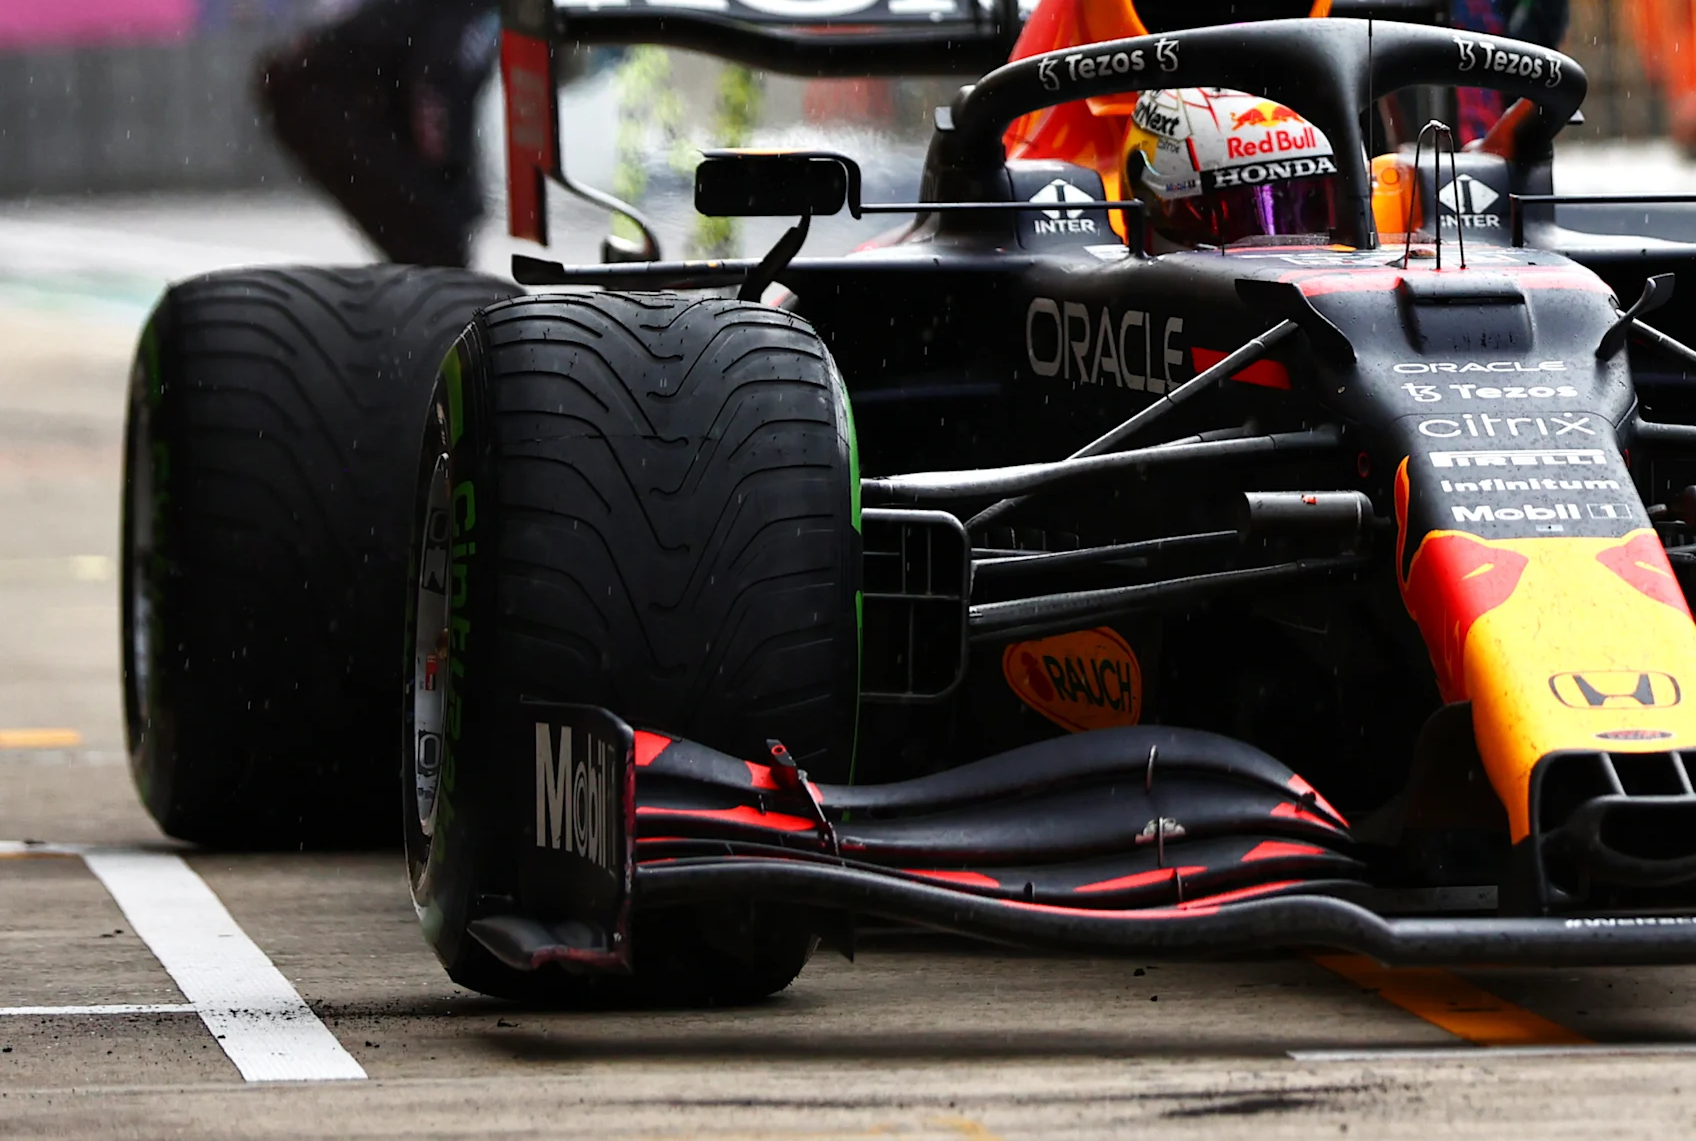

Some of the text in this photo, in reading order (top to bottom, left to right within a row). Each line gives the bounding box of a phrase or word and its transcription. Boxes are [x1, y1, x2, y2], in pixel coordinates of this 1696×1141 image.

[1064, 49, 1144, 78] Tezos
[1479, 43, 1544, 79] Tezos
[1227, 127, 1317, 159] Red Bull
[1213, 156, 1338, 189] HONDA
[1034, 219, 1097, 234] INTER
[1439, 214, 1501, 228] INTER
[1025, 296, 1185, 395] ORACLE
[1393, 360, 1568, 374] ORACLE
[1449, 383, 1579, 399] Tezos
[1418, 412, 1597, 438] citrix
[1429, 449, 1608, 468] PIRELLI
[1451, 503, 1582, 522] Mobil
[1042, 654, 1134, 715] RAUCH
[534, 721, 607, 870] Mobil
